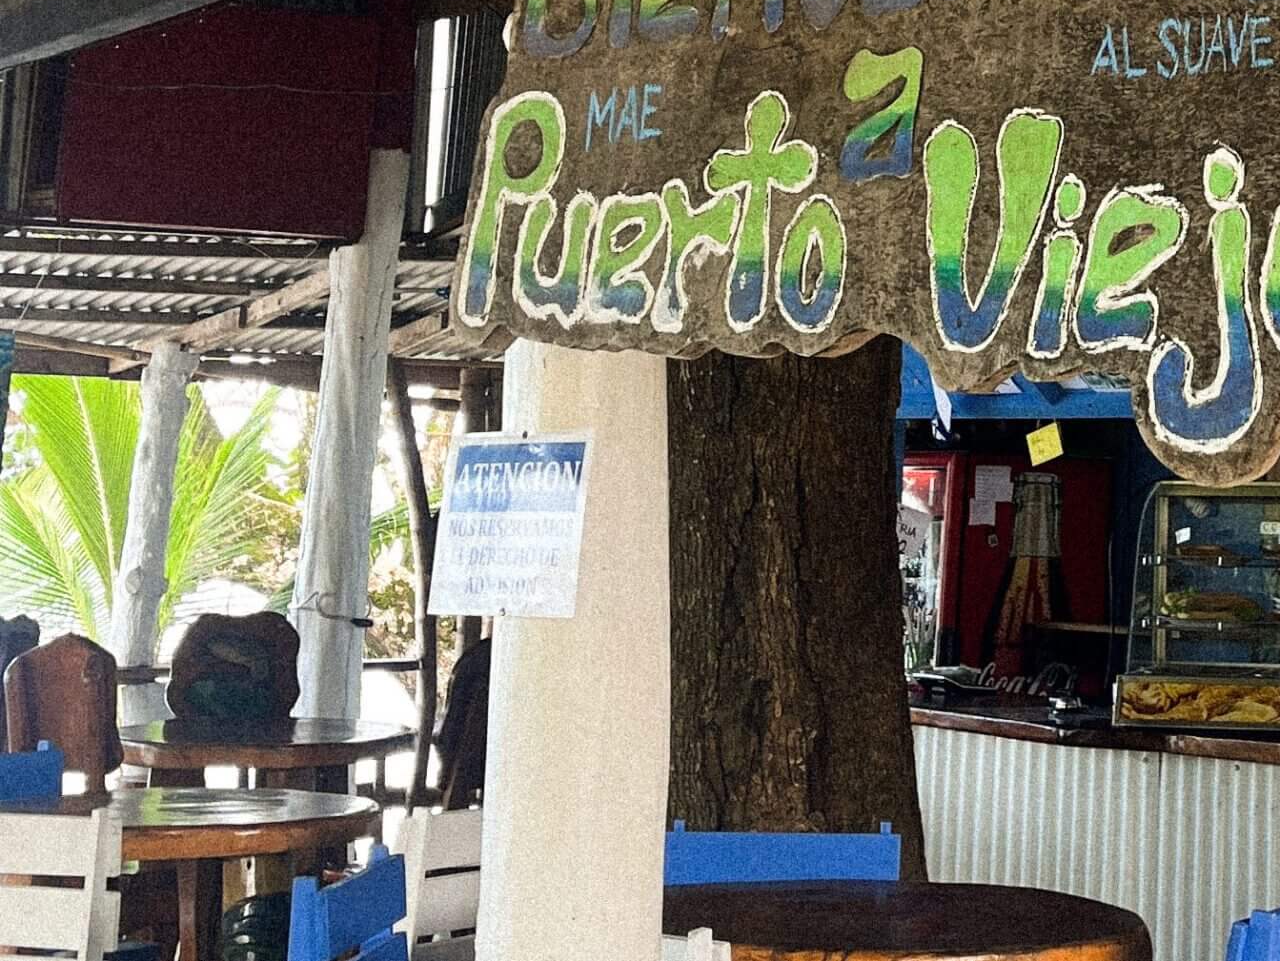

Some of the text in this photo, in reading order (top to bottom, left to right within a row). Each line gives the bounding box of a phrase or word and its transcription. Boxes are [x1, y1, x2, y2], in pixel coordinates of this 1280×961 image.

[1090, 11, 1274, 80] AL SUAVE
[585, 83, 663, 152] MAE
[457, 90, 848, 334] Puerto
[457, 461, 581, 493] ATENCION
